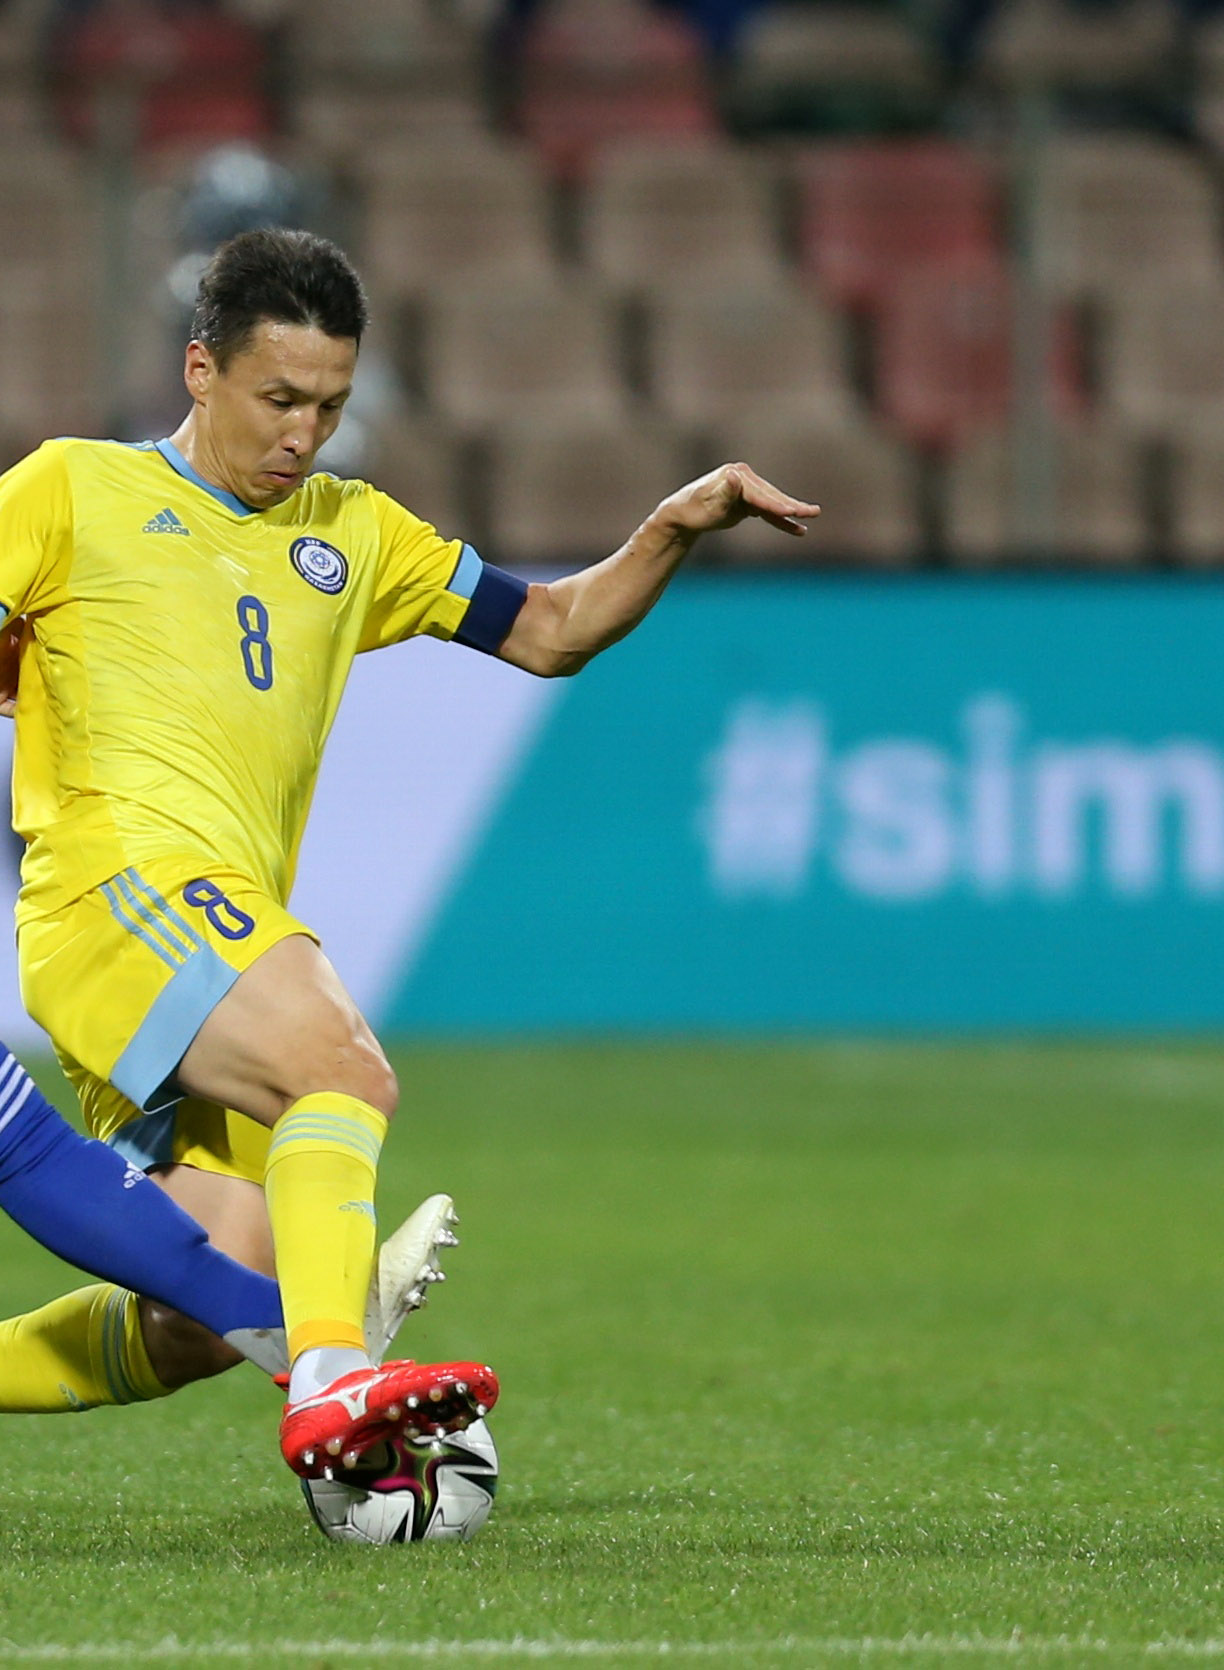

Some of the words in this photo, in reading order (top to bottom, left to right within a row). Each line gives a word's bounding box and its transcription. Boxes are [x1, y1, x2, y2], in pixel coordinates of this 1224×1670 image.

[142, 523, 191, 536] adidas
[237, 595, 273, 691] 8
[183, 878, 255, 940] 8
